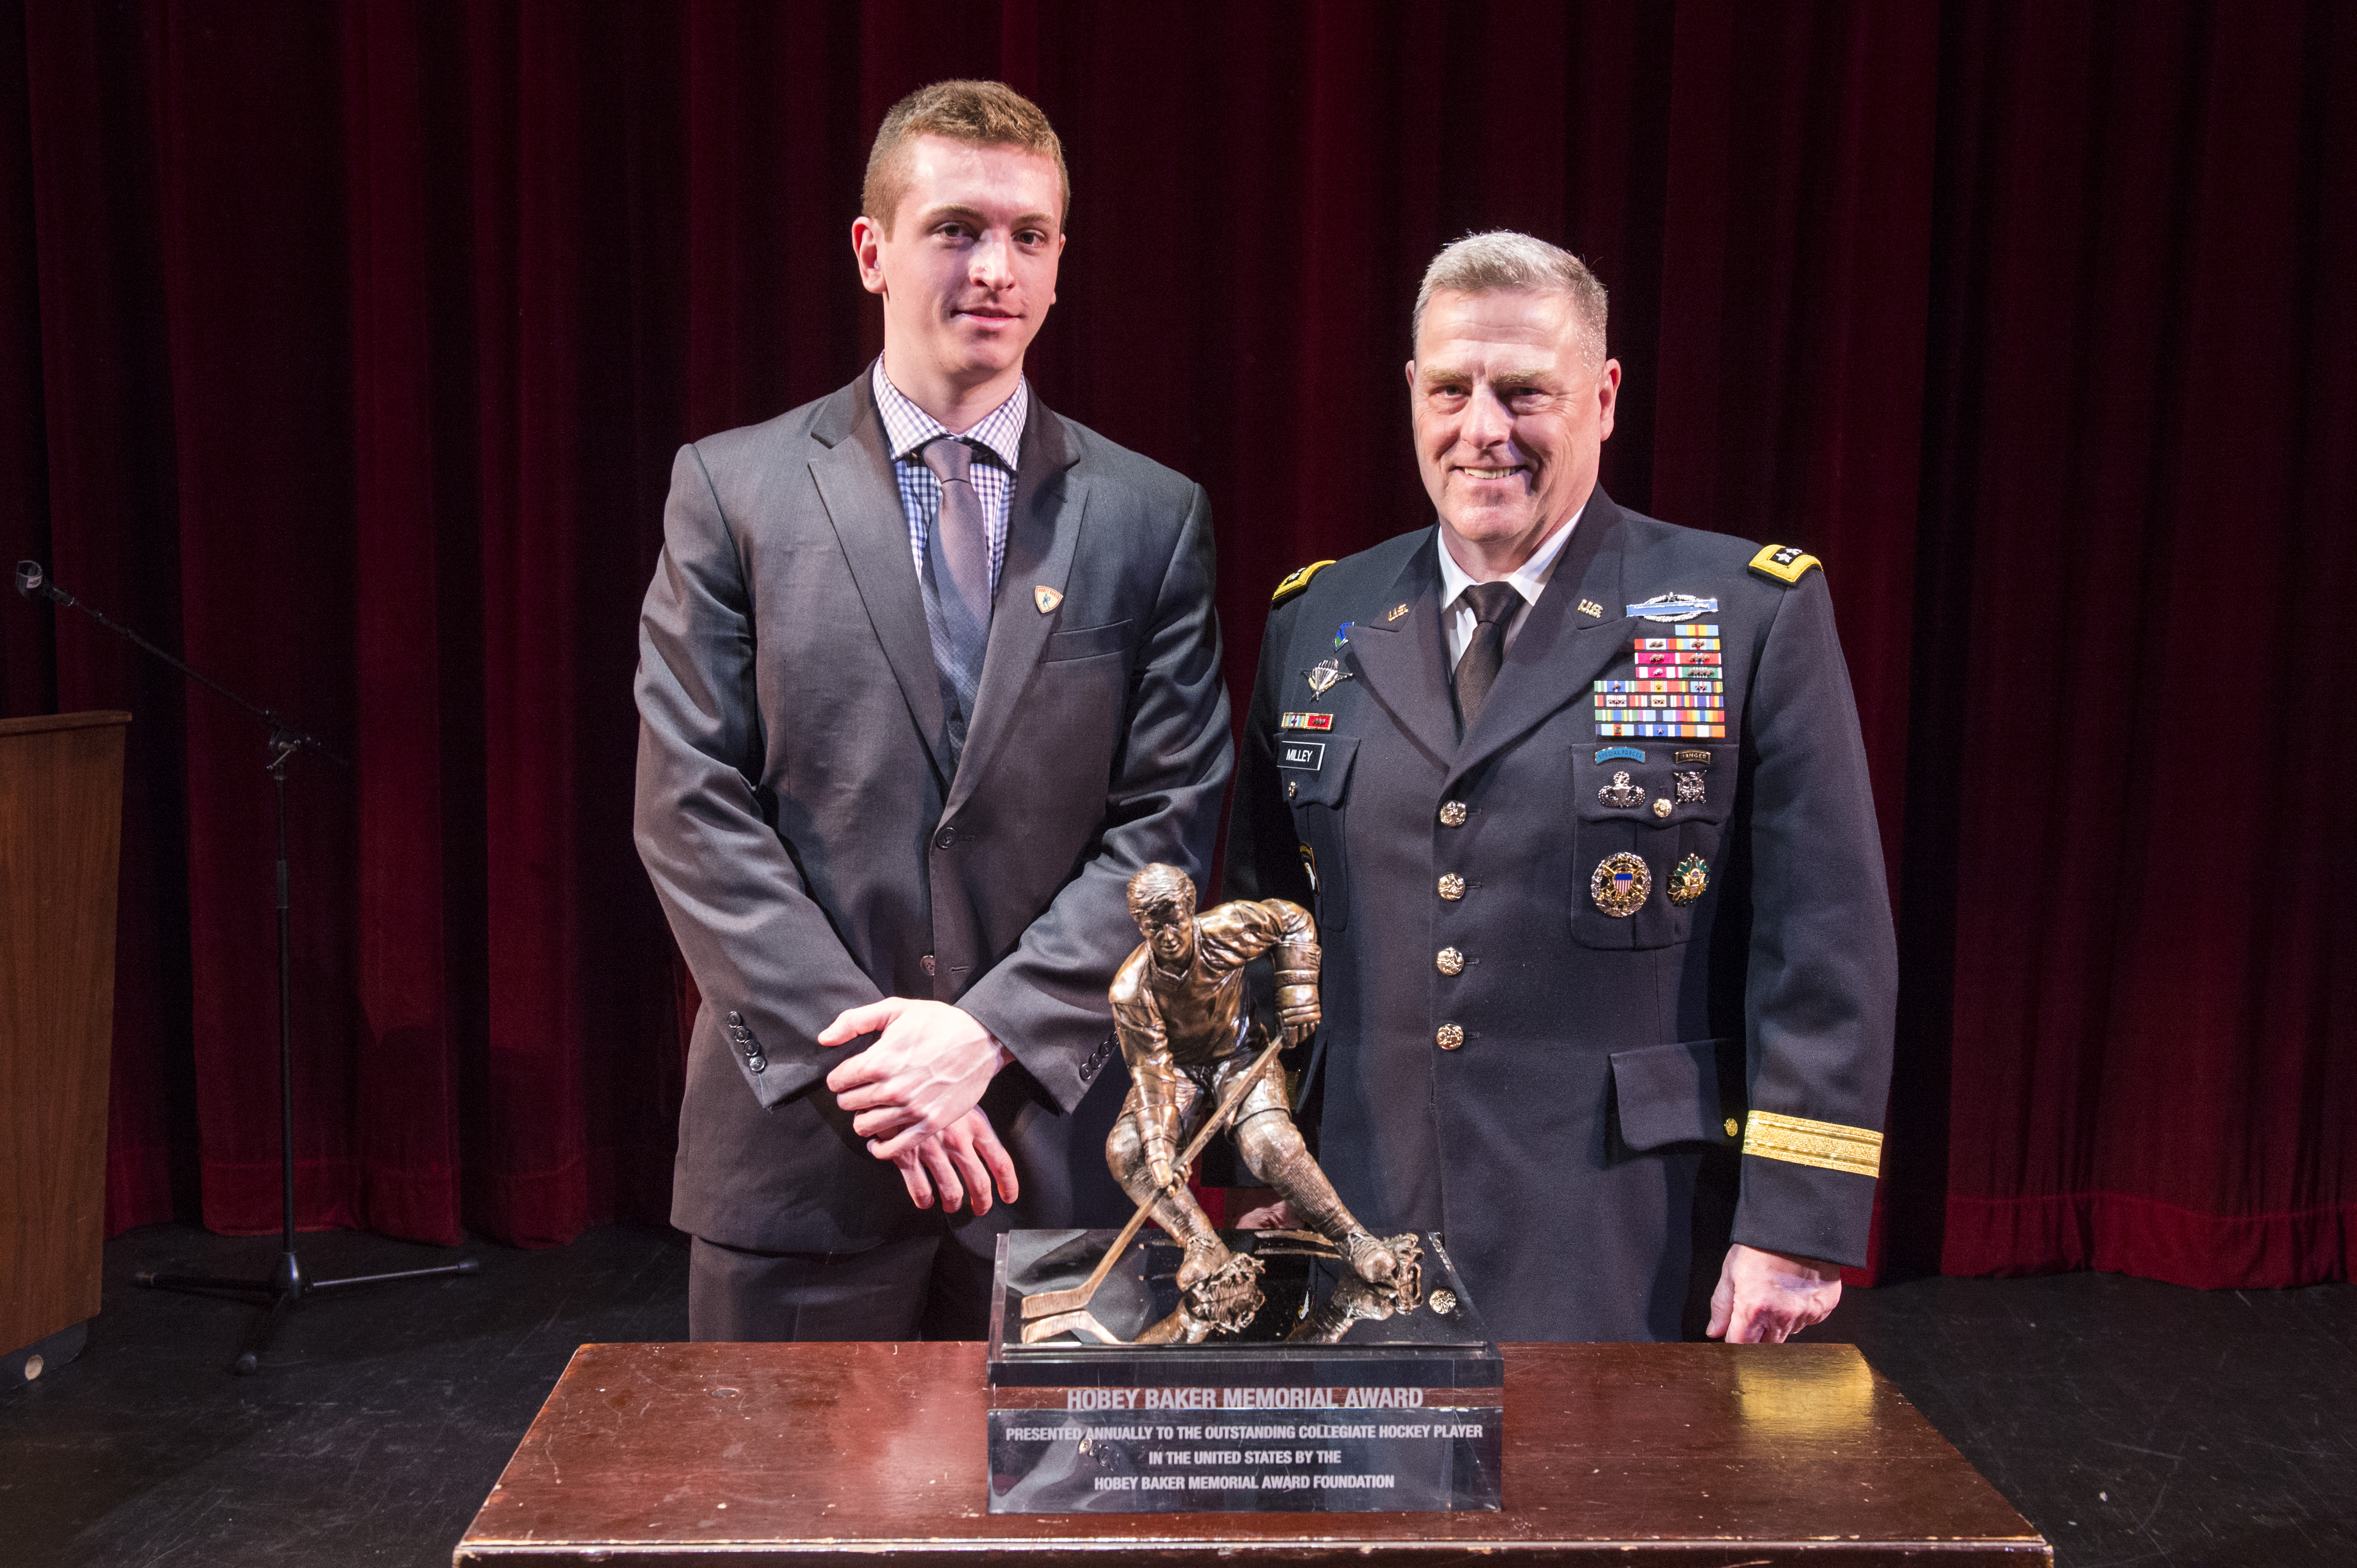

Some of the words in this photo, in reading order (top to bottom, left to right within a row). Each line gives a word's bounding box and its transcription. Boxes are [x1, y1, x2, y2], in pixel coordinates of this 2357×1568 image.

[1286, 748, 1313, 762] MILLEY
[1598, 750, 1621, 759] SPECIAL
[1622, 750, 1642, 758] FORCES
[1067, 1389, 1139, 1410] HOBEY
[1145, 1388, 1216, 1410] BAKER
[1223, 1388, 1339, 1409] MEMORIAL
[1344, 1387, 1424, 1409] AWARD
[1006, 1427, 1082, 1441] PRESENTED
[1085, 1426, 1153, 1440] ANNUALLY
[1156, 1426, 1173, 1440] TO
[1177, 1426, 1202, 1440] THE
[1205, 1425, 1296, 1439] OUTSTANDING
[1299, 1425, 1376, 1439] COLLEGIATE
[1379, 1424, 1431, 1438] HOCKEY
[1433, 1424, 1483, 1438] PLAYER
[1149, 1451, 1163, 1464] IN
[1166, 1451, 1191, 1464] THE
[1194, 1451, 1241, 1464] UNITED
[1244, 1450, 1292, 1464] STATES
[1295, 1450, 1313, 1463] BY
[1316, 1450, 1342, 1463] THE
[1094, 1476, 1138, 1490] HOBEY
[1141, 1476, 1186, 1490] BAKER
[1189, 1476, 1259, 1489] MEMORIAL
[1262, 1475, 1310, 1489] AWARD
[1313, 1475, 1394, 1488] FOUNDATION
